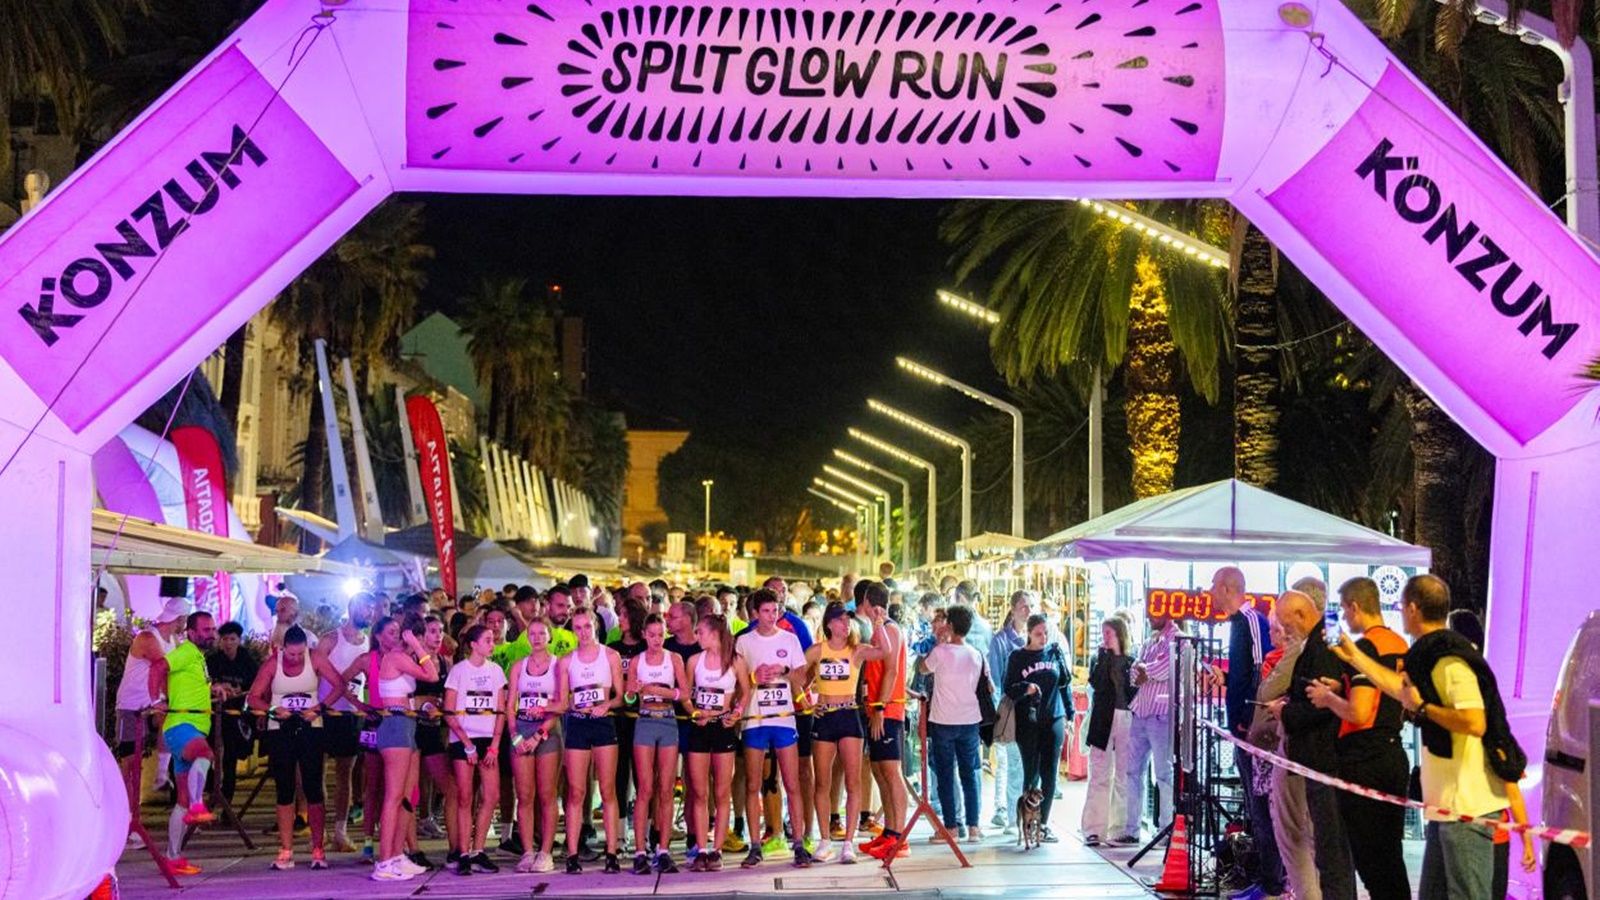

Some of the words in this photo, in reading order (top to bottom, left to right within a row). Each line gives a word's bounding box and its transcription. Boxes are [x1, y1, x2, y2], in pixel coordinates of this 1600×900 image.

[602, 41, 742, 94] SPLIT
[746, 47, 881, 98] GLOW
[890, 50, 1008, 100] RUN
[18, 123, 268, 347] KONZUM
[1354, 137, 1580, 360] KONZUM
[824, 665, 844, 674] 213
[579, 690, 599, 702] 220
[700, 694, 718, 704] 173
[763, 690, 783, 700] 219
[288, 698, 307, 707] 217
[473, 698, 490, 707] 171
